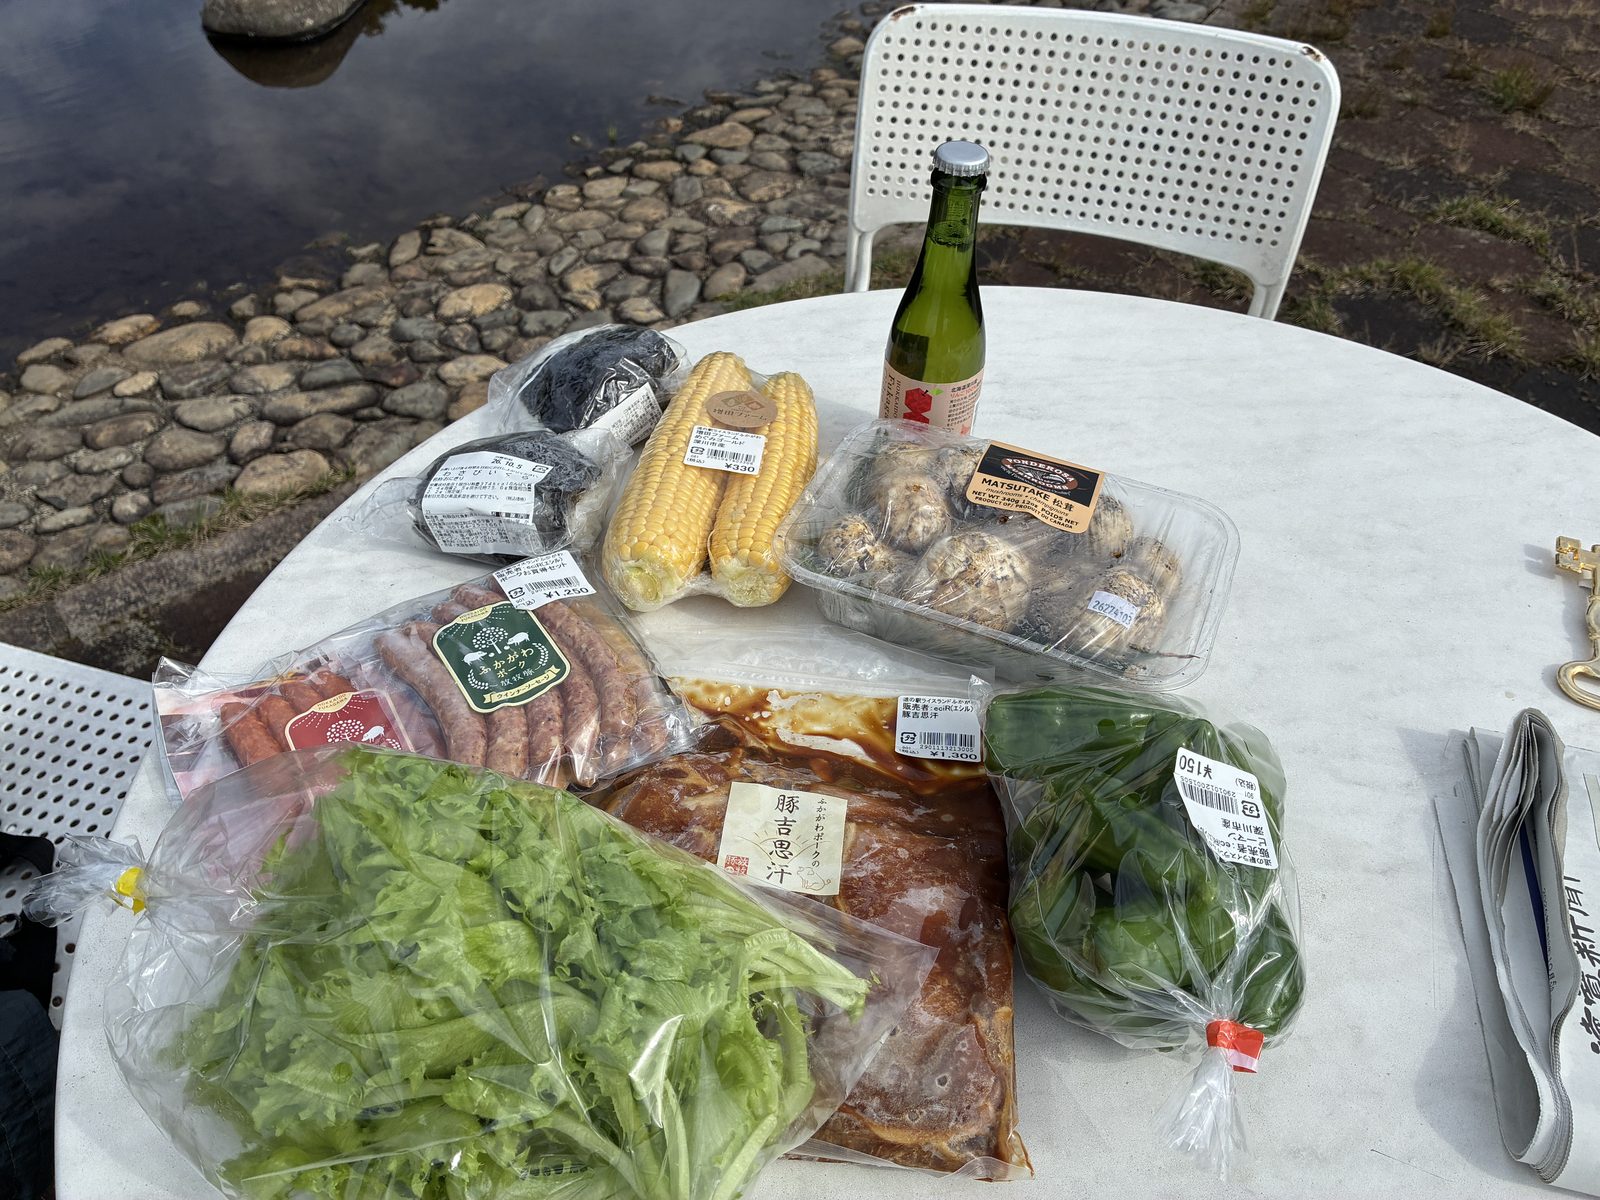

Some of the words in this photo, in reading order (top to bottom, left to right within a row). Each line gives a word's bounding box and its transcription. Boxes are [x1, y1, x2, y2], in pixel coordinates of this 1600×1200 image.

[725, 463, 756, 473] ¥330
[1006, 458, 1075, 482] PONDEROSA
[981, 478, 1051, 502] MATSUTAKE
[1052, 498, 1075, 513] 松茸
[986, 488, 1023, 498] mushrooms
[1030, 496, 1069, 517] champignons
[972, 490, 987, 498] NET
[1041, 508, 1063, 521] POIDS
[1064, 518, 1080, 526] NET
[974, 496, 1002, 506] PRODUCT
[1015, 504, 1041, 516] PRODUIT
[1049, 517, 1073, 529] CANADA
[544, 587, 589, 599] ¥1,250
[479, 648, 534, 675] ふかがわ
[496, 660, 526, 679] ポーク
[496, 674, 550, 699] ウインナーソーセージ
[500, 668, 535, 687] 放牧豚
[902, 711, 939, 719] 豚吉思汗
[920, 744, 974, 753] 2901113213005
[1179, 755, 1212, 780] ¥150
[1235, 777, 1257, 791] (税込)
[811, 798, 828, 868] ふかがわポークの
[1221, 818, 1264, 836] 深川市産
[766, 794, 800, 885] 豚吉思汗
[1228, 832, 1267, 847] ピーマン
